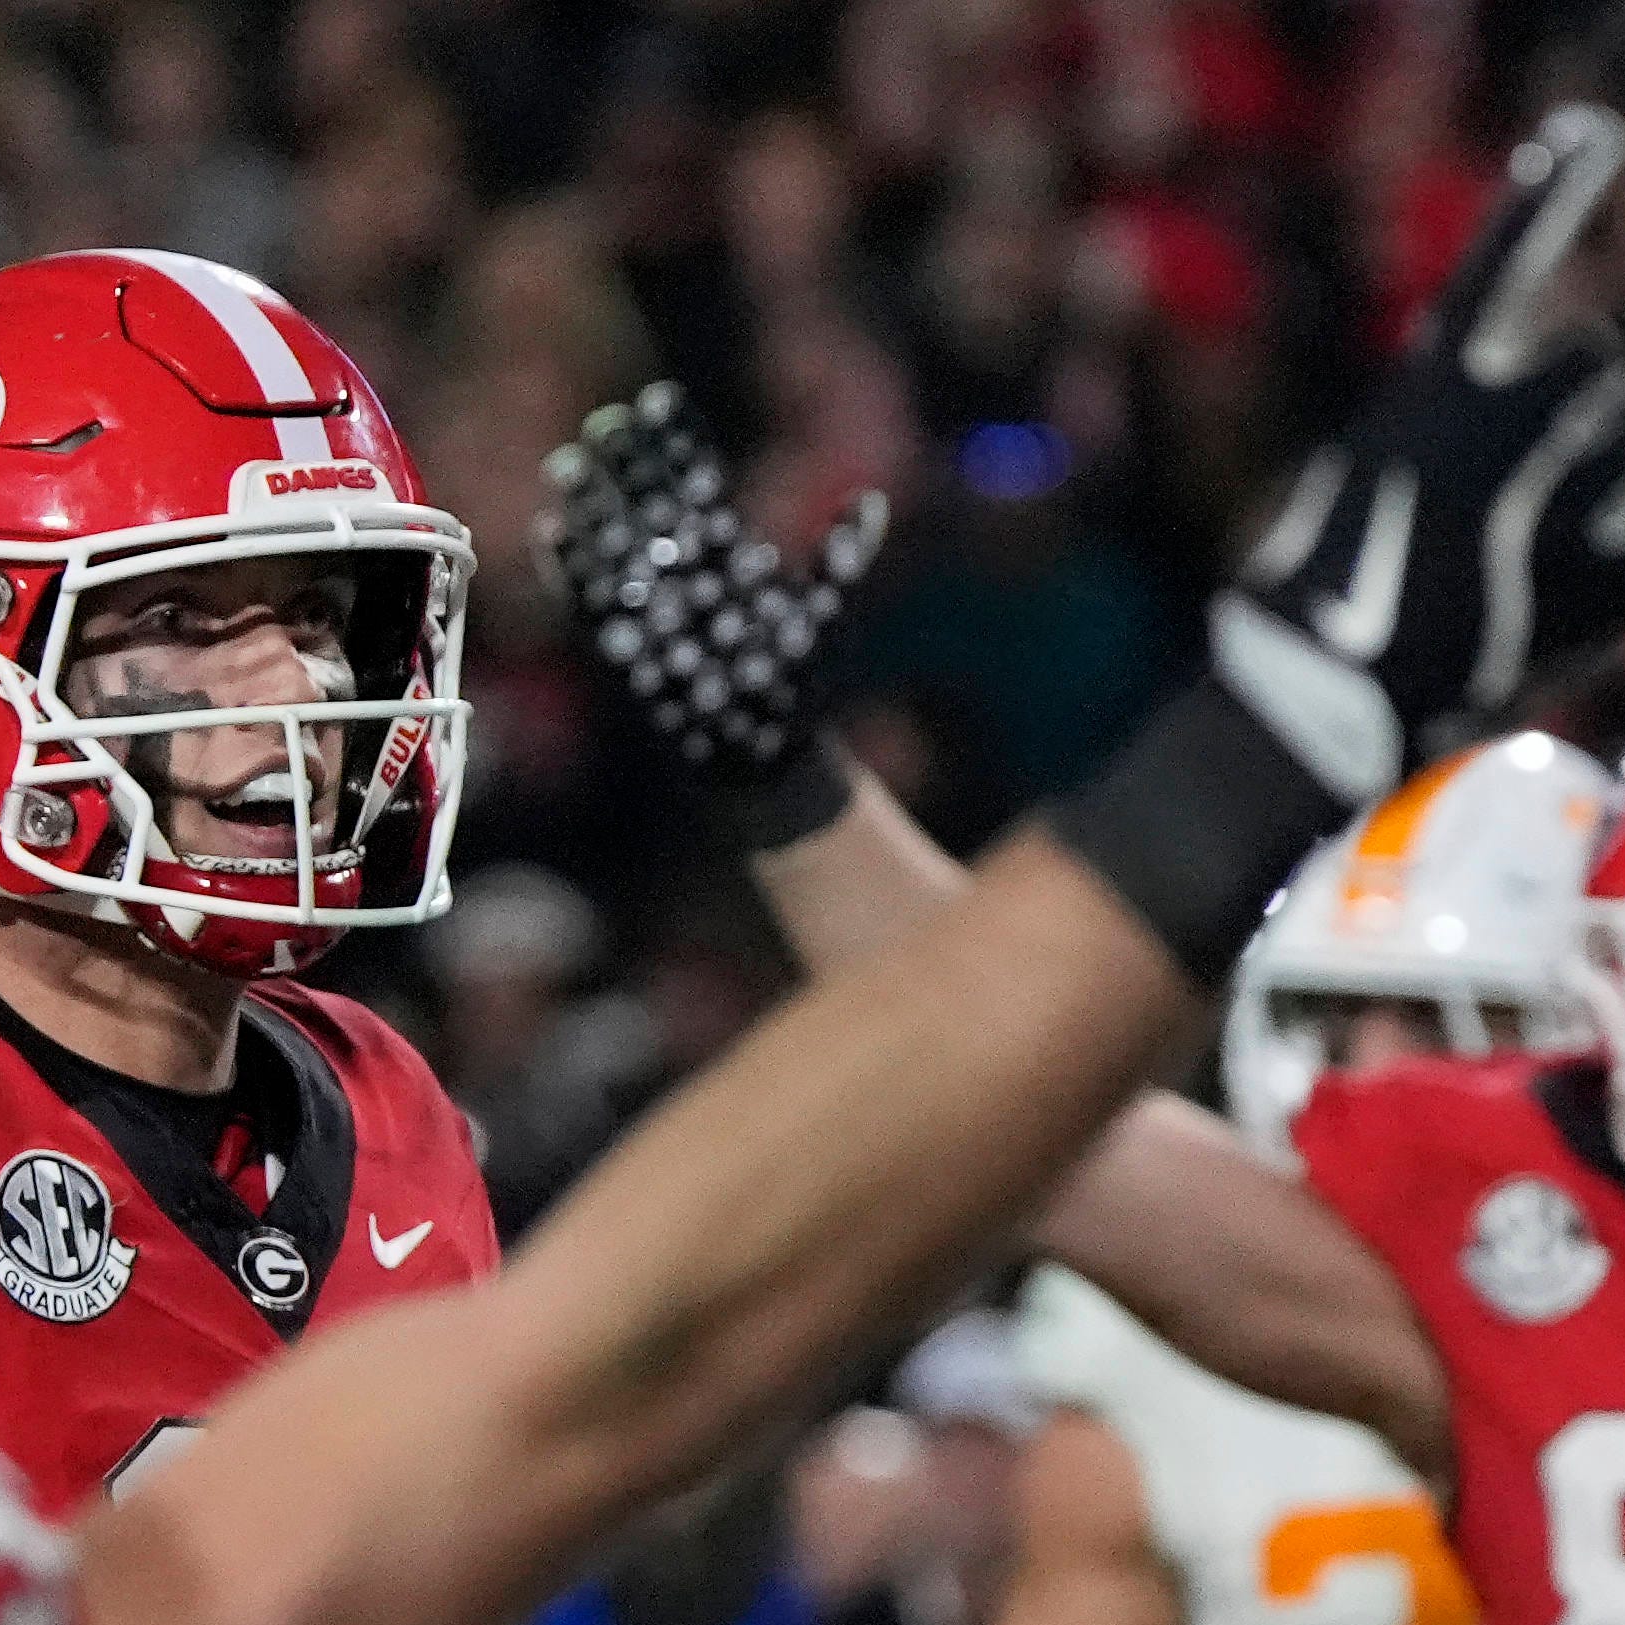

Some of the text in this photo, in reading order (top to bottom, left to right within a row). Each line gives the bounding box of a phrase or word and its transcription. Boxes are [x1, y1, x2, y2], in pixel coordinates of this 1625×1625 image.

[266, 466, 377, 495] DAWGS
[1, 1157, 101, 1278] SEC
[4, 1269, 123, 1318] GRADUATE
[240, 1240, 307, 1299] G
